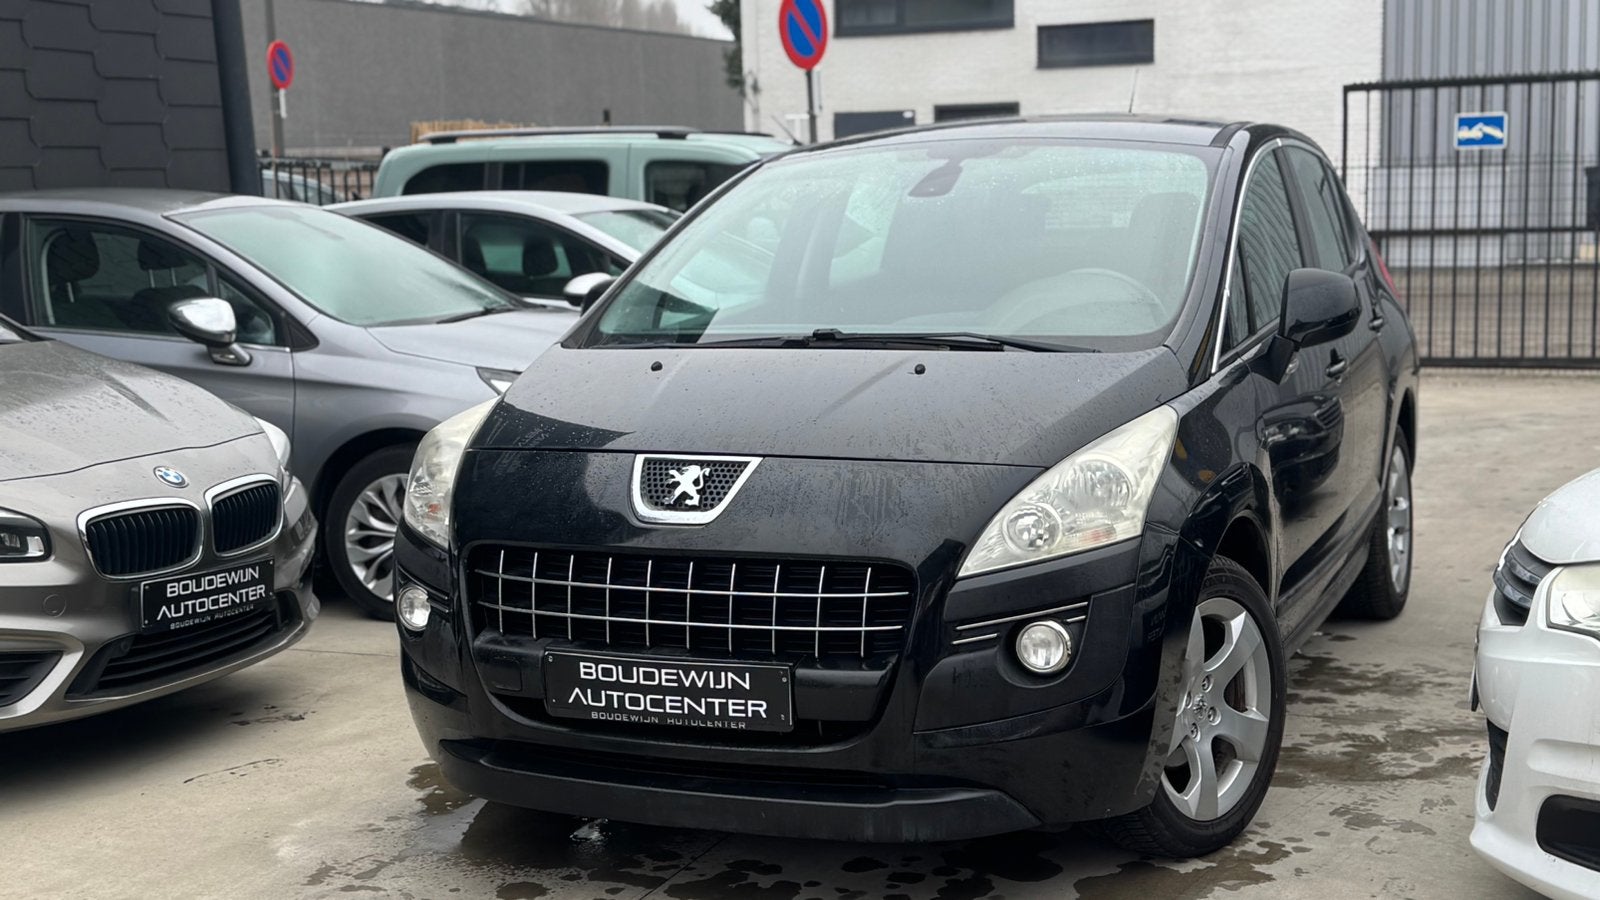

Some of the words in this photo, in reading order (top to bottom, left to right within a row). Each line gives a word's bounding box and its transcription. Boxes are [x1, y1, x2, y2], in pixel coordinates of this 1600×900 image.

[167, 566, 259, 597] BOUDEWIJN
[157, 584, 266, 620] AUTOCENTER
[579, 662, 750, 690] BOUDEWIJN
[568, 687, 767, 718] AUTOCENTER
[591, 711, 659, 724] BOUDEWIJN
